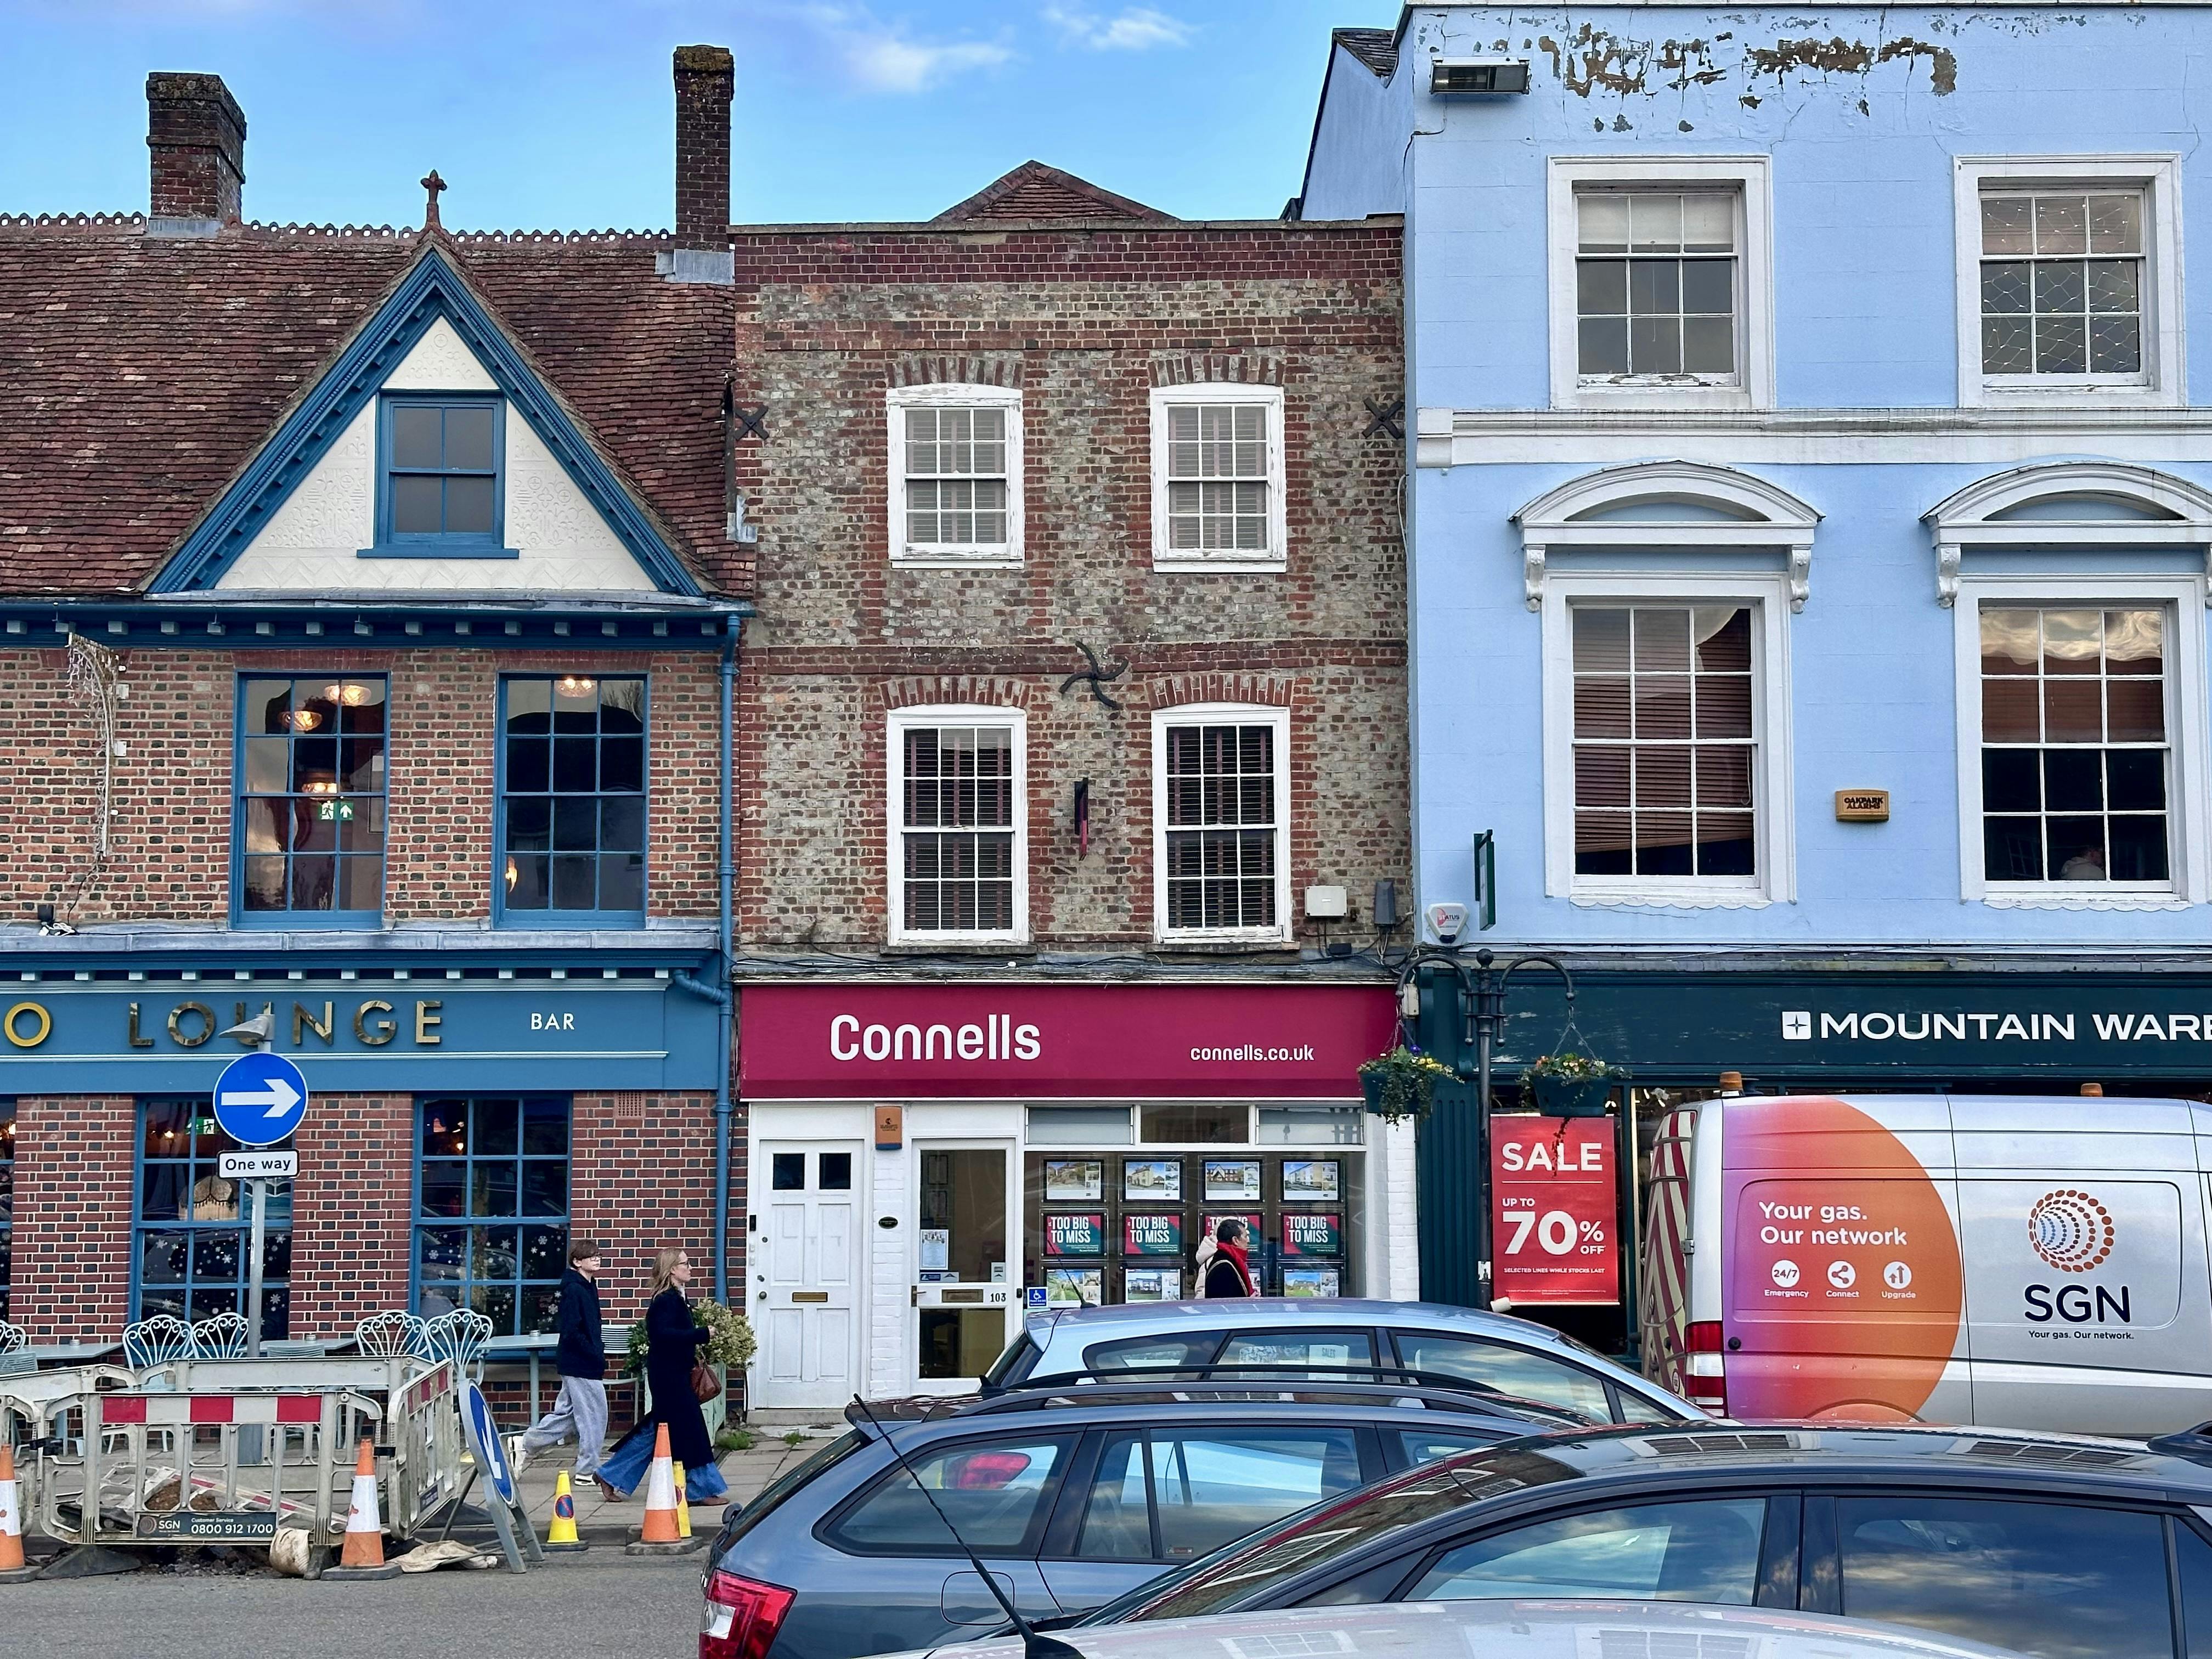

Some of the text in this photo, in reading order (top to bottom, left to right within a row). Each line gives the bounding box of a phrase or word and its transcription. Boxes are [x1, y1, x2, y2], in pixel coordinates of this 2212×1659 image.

[4, 1002, 50, 1047] O
[532, 1013, 574, 1030] BAR
[1821, 1013, 2074, 1040] MOUNTAIN
[831, 1014, 1040, 1060] Connells
[1191, 1045, 1314, 1060] connells.co.uk
[1502, 1142, 1602, 1171] SALE
[225, 1159, 291, 1171] One way
[1502, 1198, 1534, 1206] UP TO
[1759, 1202, 1867, 1223] Your gas.
[1051, 1217, 1071, 1230] TOO
[1073, 1217, 1088, 1230] BIG
[1130, 1217, 1167, 1230] TOO BIG
[1288, 1216, 1327, 1229] TOO BIG
[1051, 1231, 1090, 1243] TO MISS
[1130, 1231, 1169, 1243] TO MISS
[1289, 1230, 1328, 1243] TO MISS
[1761, 1226, 1906, 1245] Our network
[1581, 1246, 1605, 1254] OFF
[1774, 1269, 1797, 1279] 24/7
[990, 1293, 1006, 1302] 103
[1764, 1289, 1808, 1298] Emergency
[2024, 1284, 2130, 1323] SGN
[159, 1521, 180, 1529] SGN
[191, 1524, 273, 1534] 0800 912 1700
